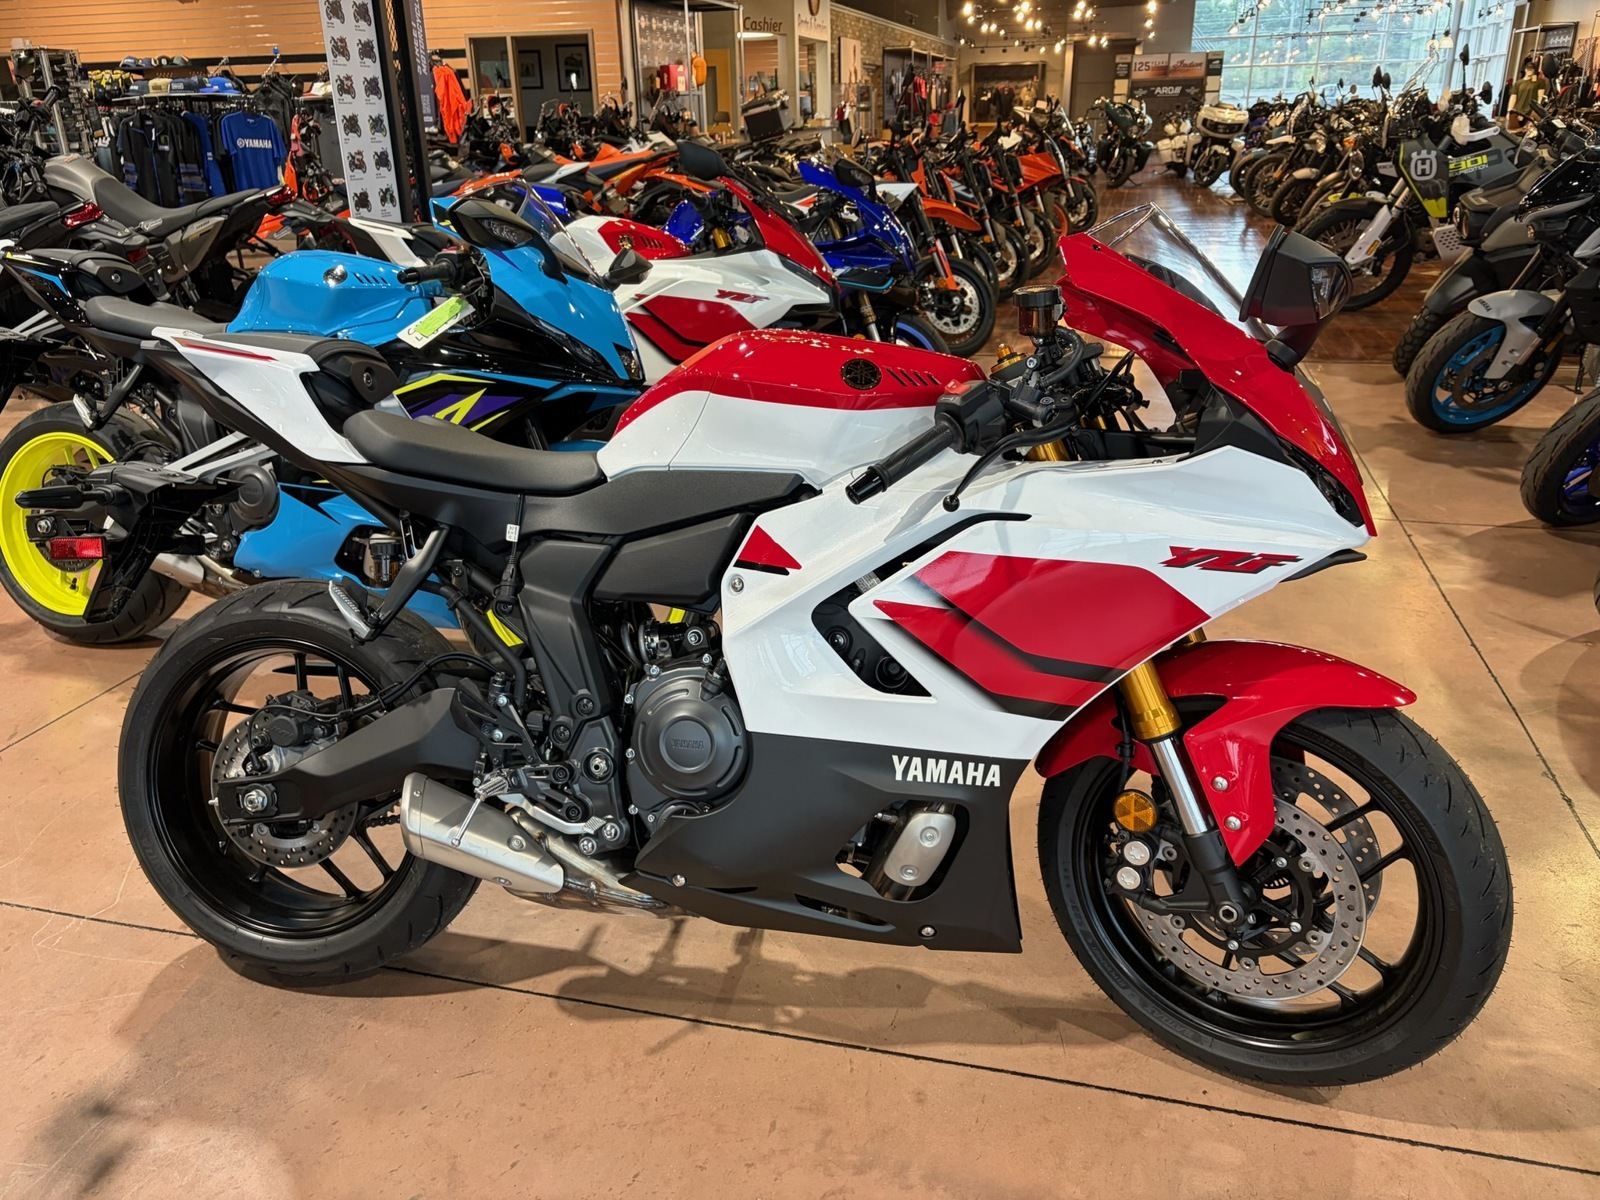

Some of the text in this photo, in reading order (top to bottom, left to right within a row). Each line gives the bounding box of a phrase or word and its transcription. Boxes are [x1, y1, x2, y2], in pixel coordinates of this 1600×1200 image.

[743, 16, 783, 32] Cashier
[413, 0, 428, 76] MOTORCYCL
[1133, 61, 1151, 72] 125
[244, 138, 273, 149] YAMAHA
[891, 754, 1001, 787] YAMAHA
